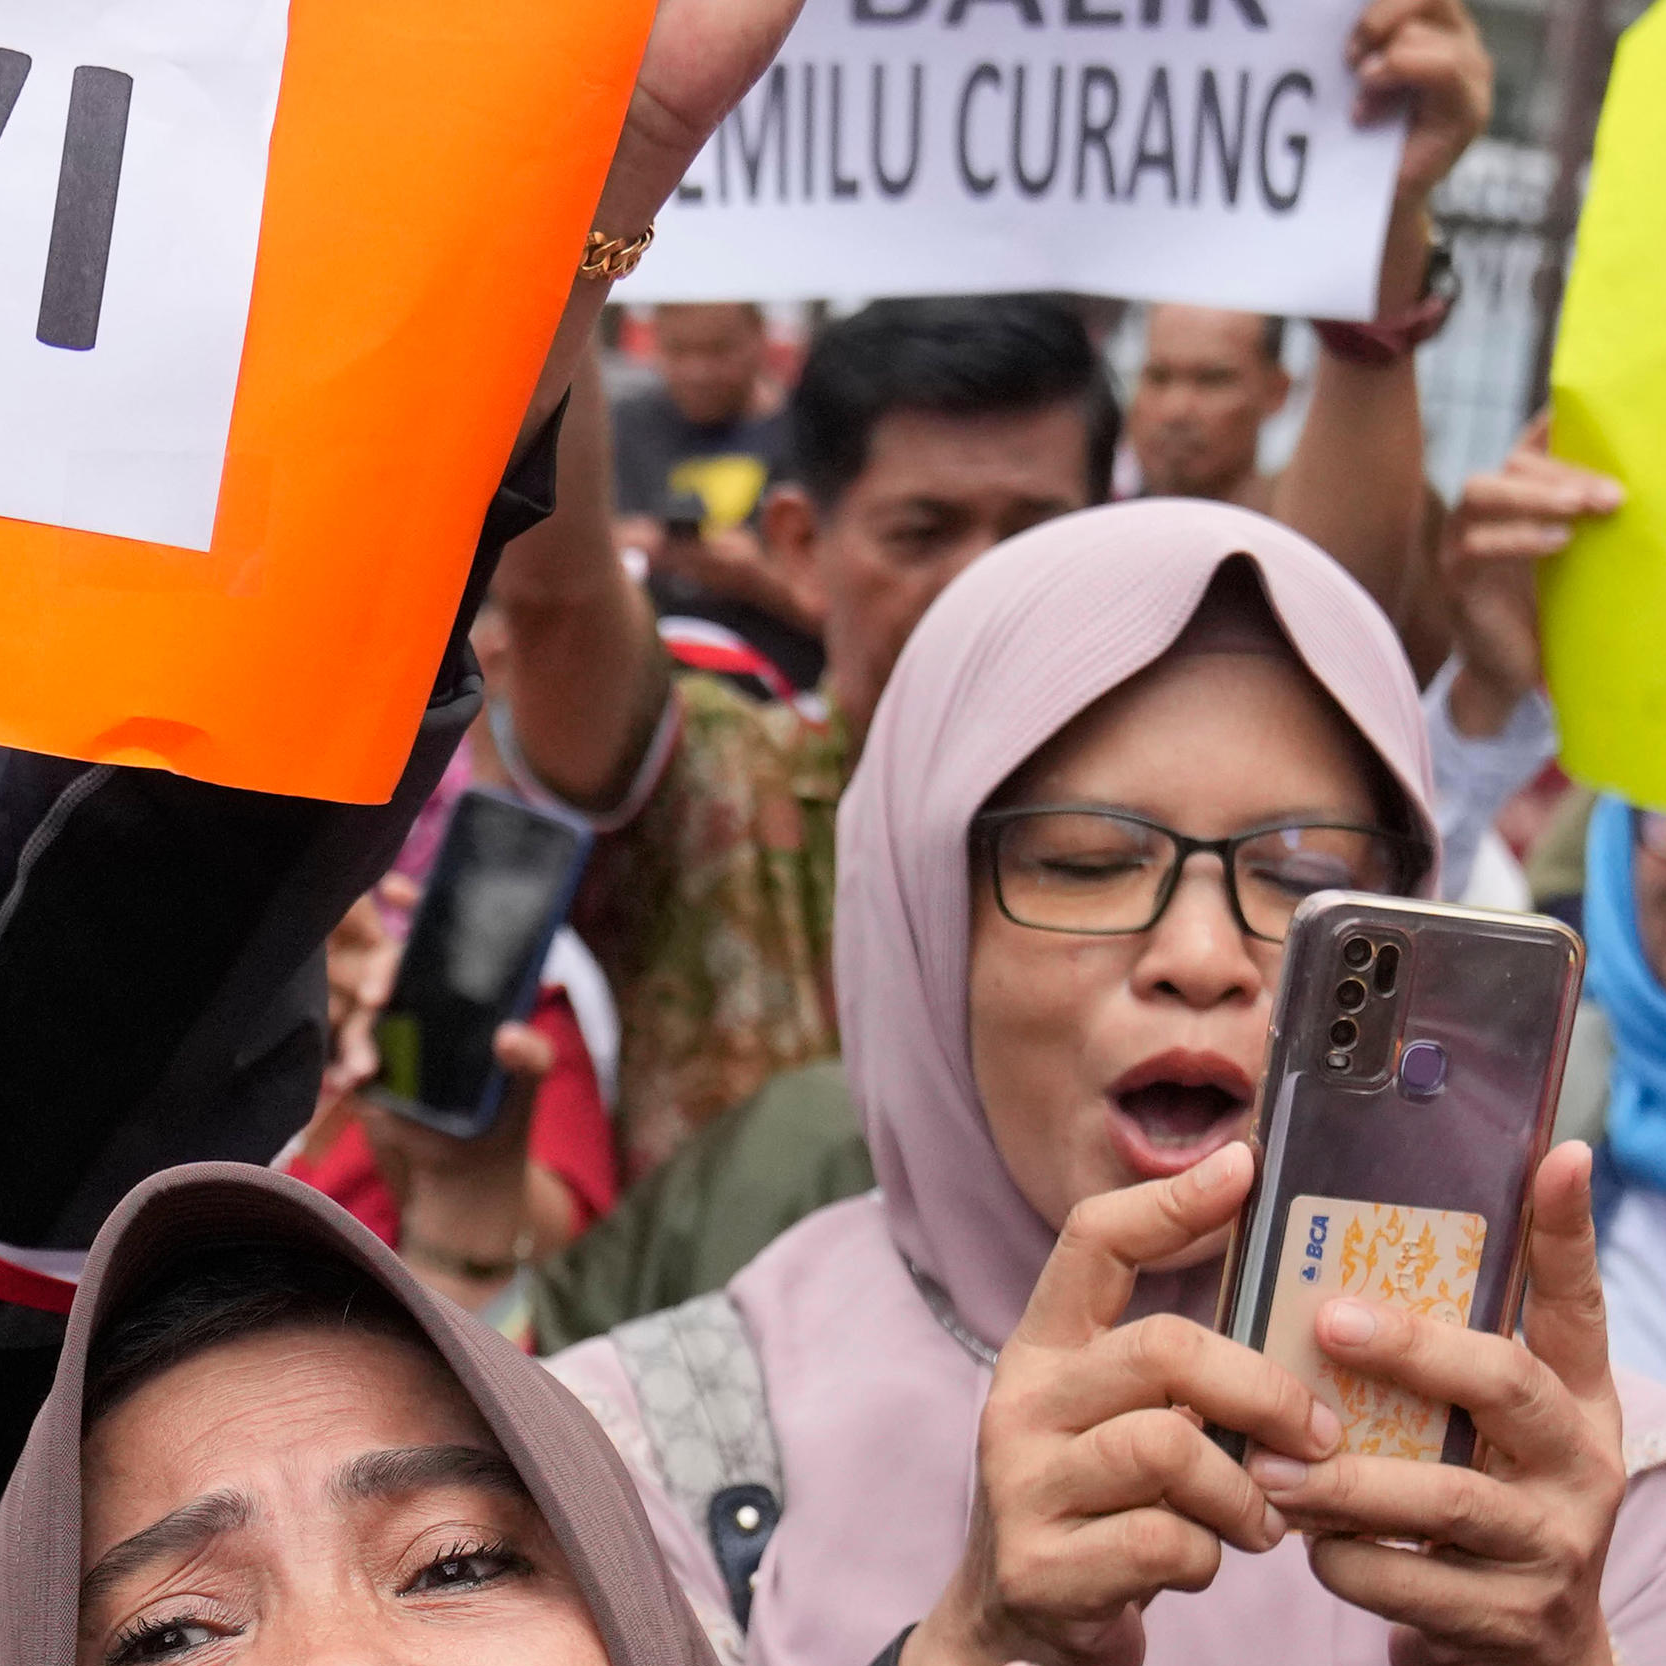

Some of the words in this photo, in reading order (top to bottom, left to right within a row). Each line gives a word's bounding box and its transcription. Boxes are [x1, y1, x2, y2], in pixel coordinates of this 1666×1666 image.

[675, 60, 925, 207] MILU
[954, 60, 1318, 213] CURANG
[1306, 1216, 1329, 1260] BCA
